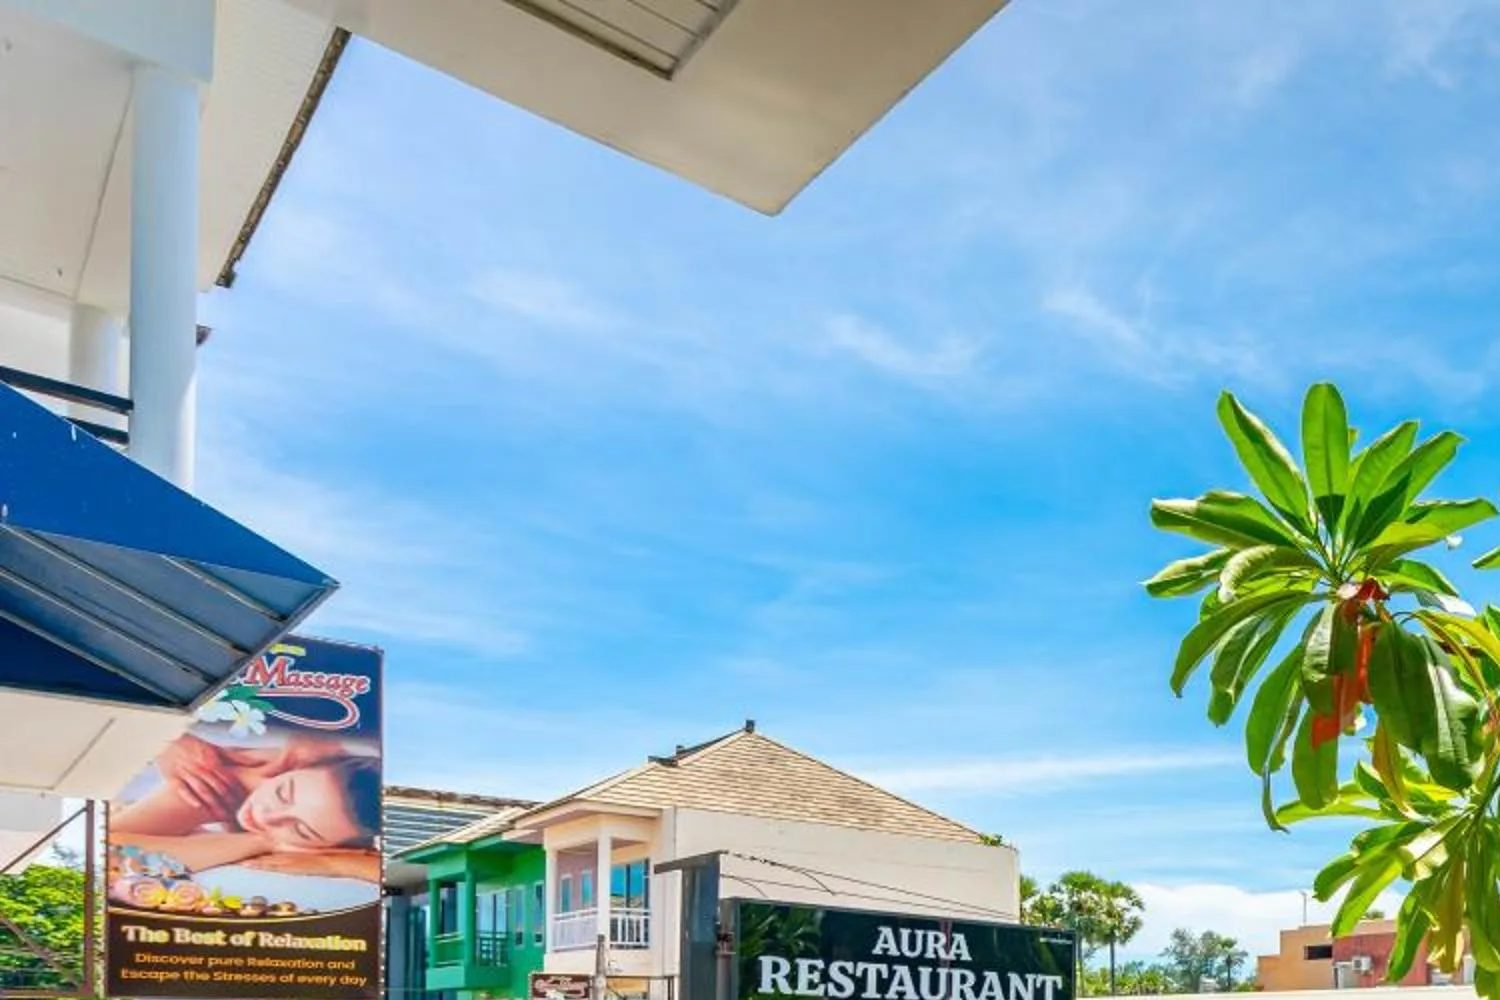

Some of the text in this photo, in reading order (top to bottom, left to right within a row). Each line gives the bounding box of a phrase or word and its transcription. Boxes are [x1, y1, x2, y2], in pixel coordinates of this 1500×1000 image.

[244, 655, 371, 699] Massage
[121, 925, 367, 951] The Best of Relaxation
[871, 926, 973, 961] AURA
[135, 953, 355, 970] Discover pure Relaxation and
[121, 968, 367, 987] Escape the Stresses of every day
